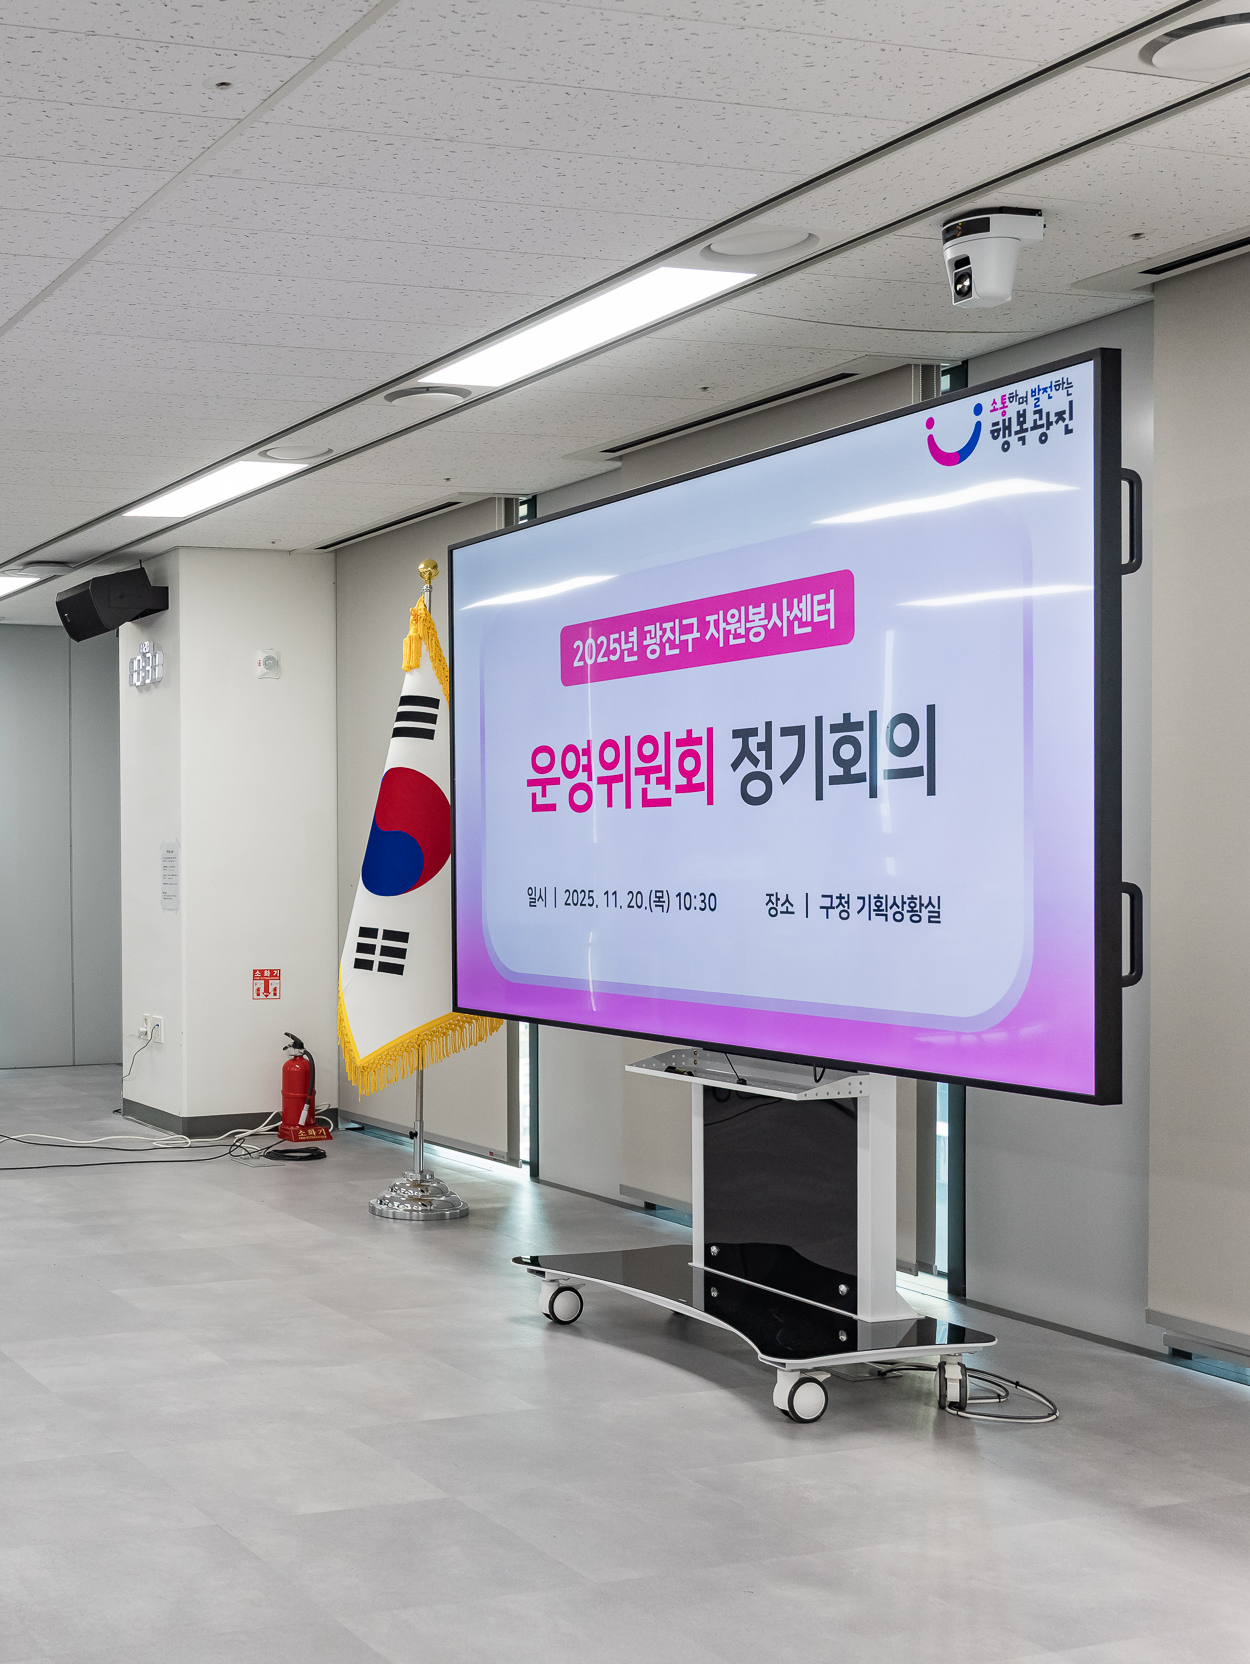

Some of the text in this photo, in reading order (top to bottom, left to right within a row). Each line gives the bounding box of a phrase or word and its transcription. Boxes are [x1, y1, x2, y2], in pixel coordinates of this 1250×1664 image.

[989, 376, 1074, 417] 소통하며 발전하는
[989, 399, 1074, 453] 행복광진
[572, 588, 835, 667] 2025년 광진구 자원봉사센터
[526, 703, 936, 814] 운영위원회 정기회의
[526, 886, 548, 908] 일시
[564, 888, 599, 909] 2025.
[603, 889, 623, 910] 11.
[675, 891, 718, 913] 10:30
[765, 891, 942, 924] 장소 구청 기획상황실
[254, 969, 280, 977] 소화기
[298, 1128, 327, 1136] 소화기
